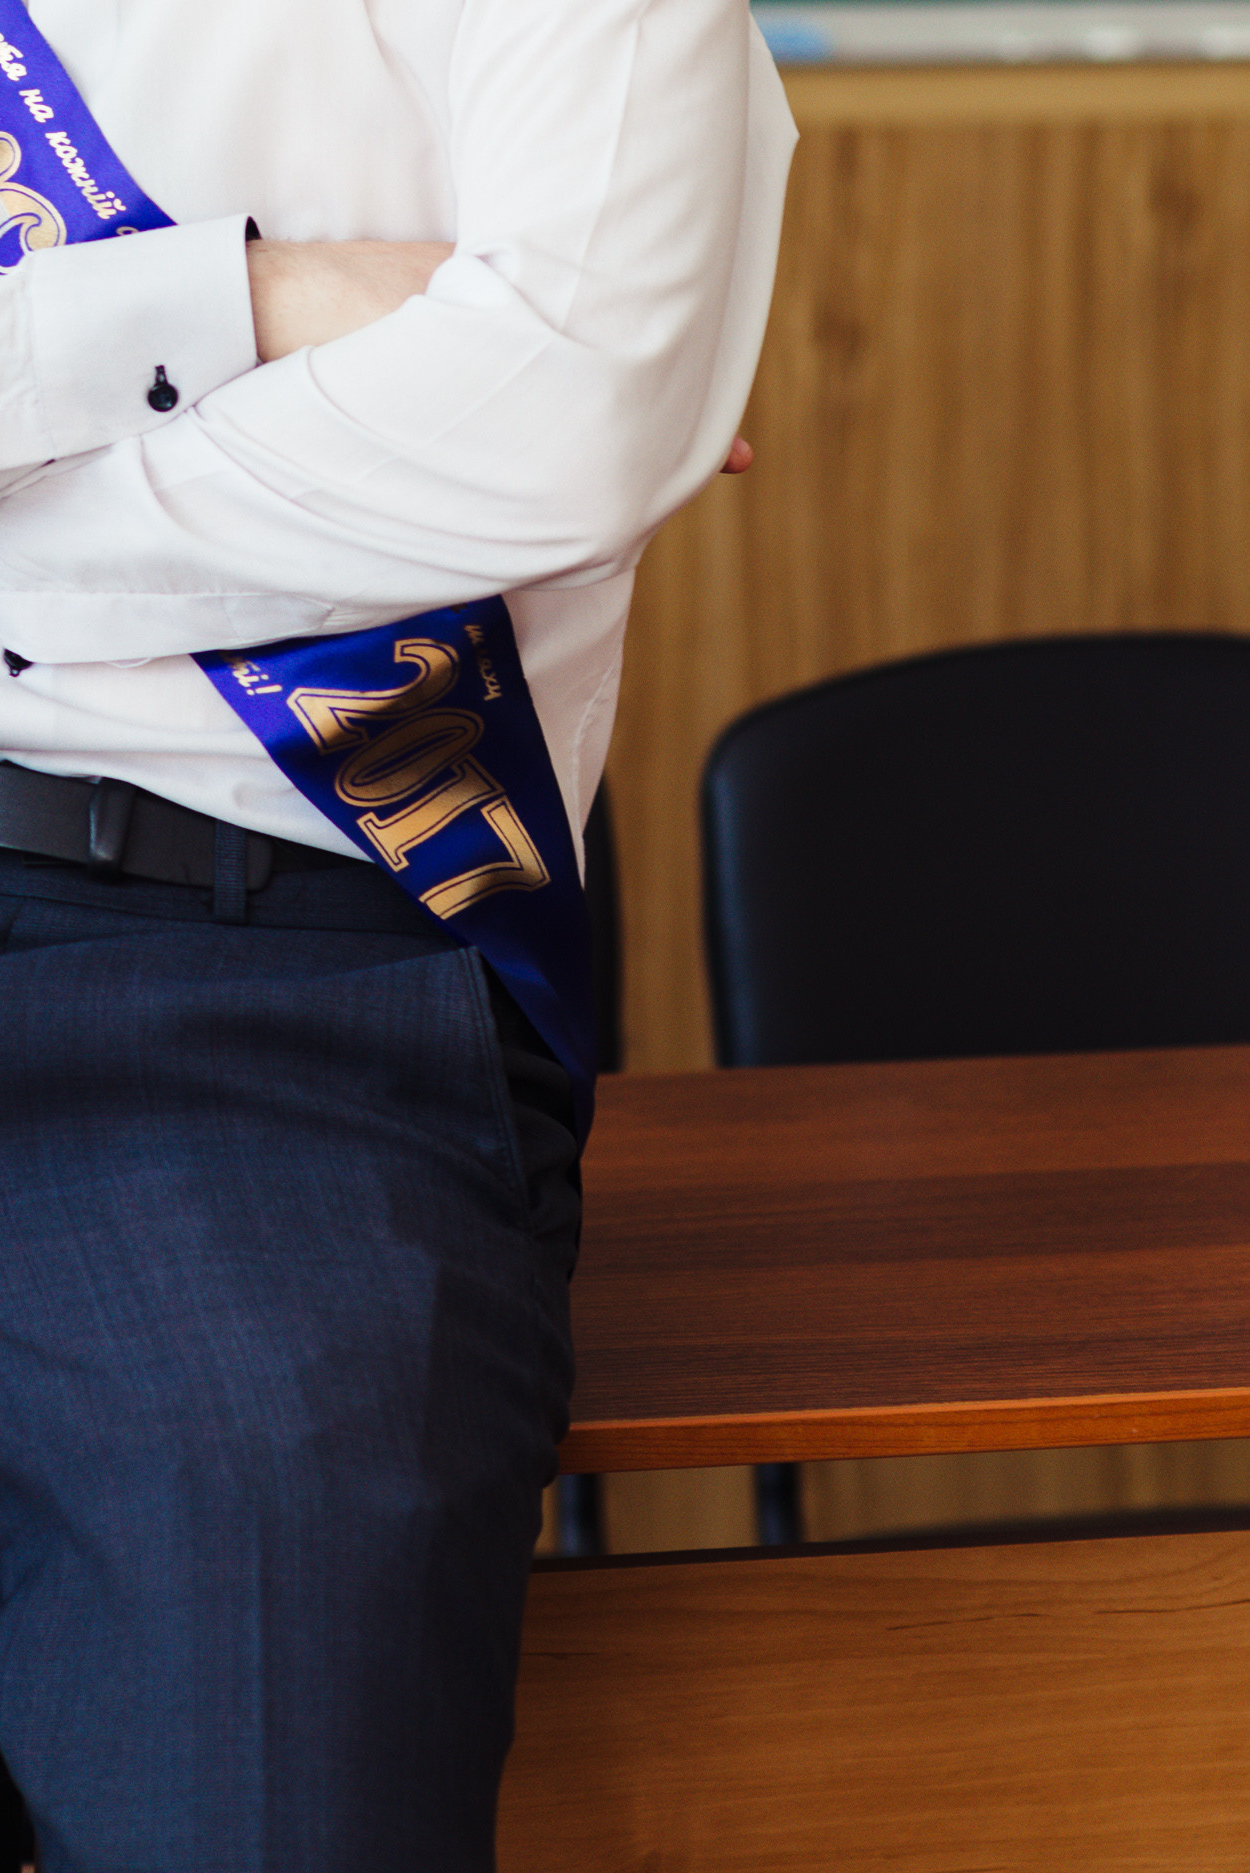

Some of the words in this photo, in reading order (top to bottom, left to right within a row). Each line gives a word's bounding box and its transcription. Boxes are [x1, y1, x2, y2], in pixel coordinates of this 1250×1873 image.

[18, 88, 55, 123] на
[44, 131, 127, 220] кожній
[286, 637, 551, 920] 2017
